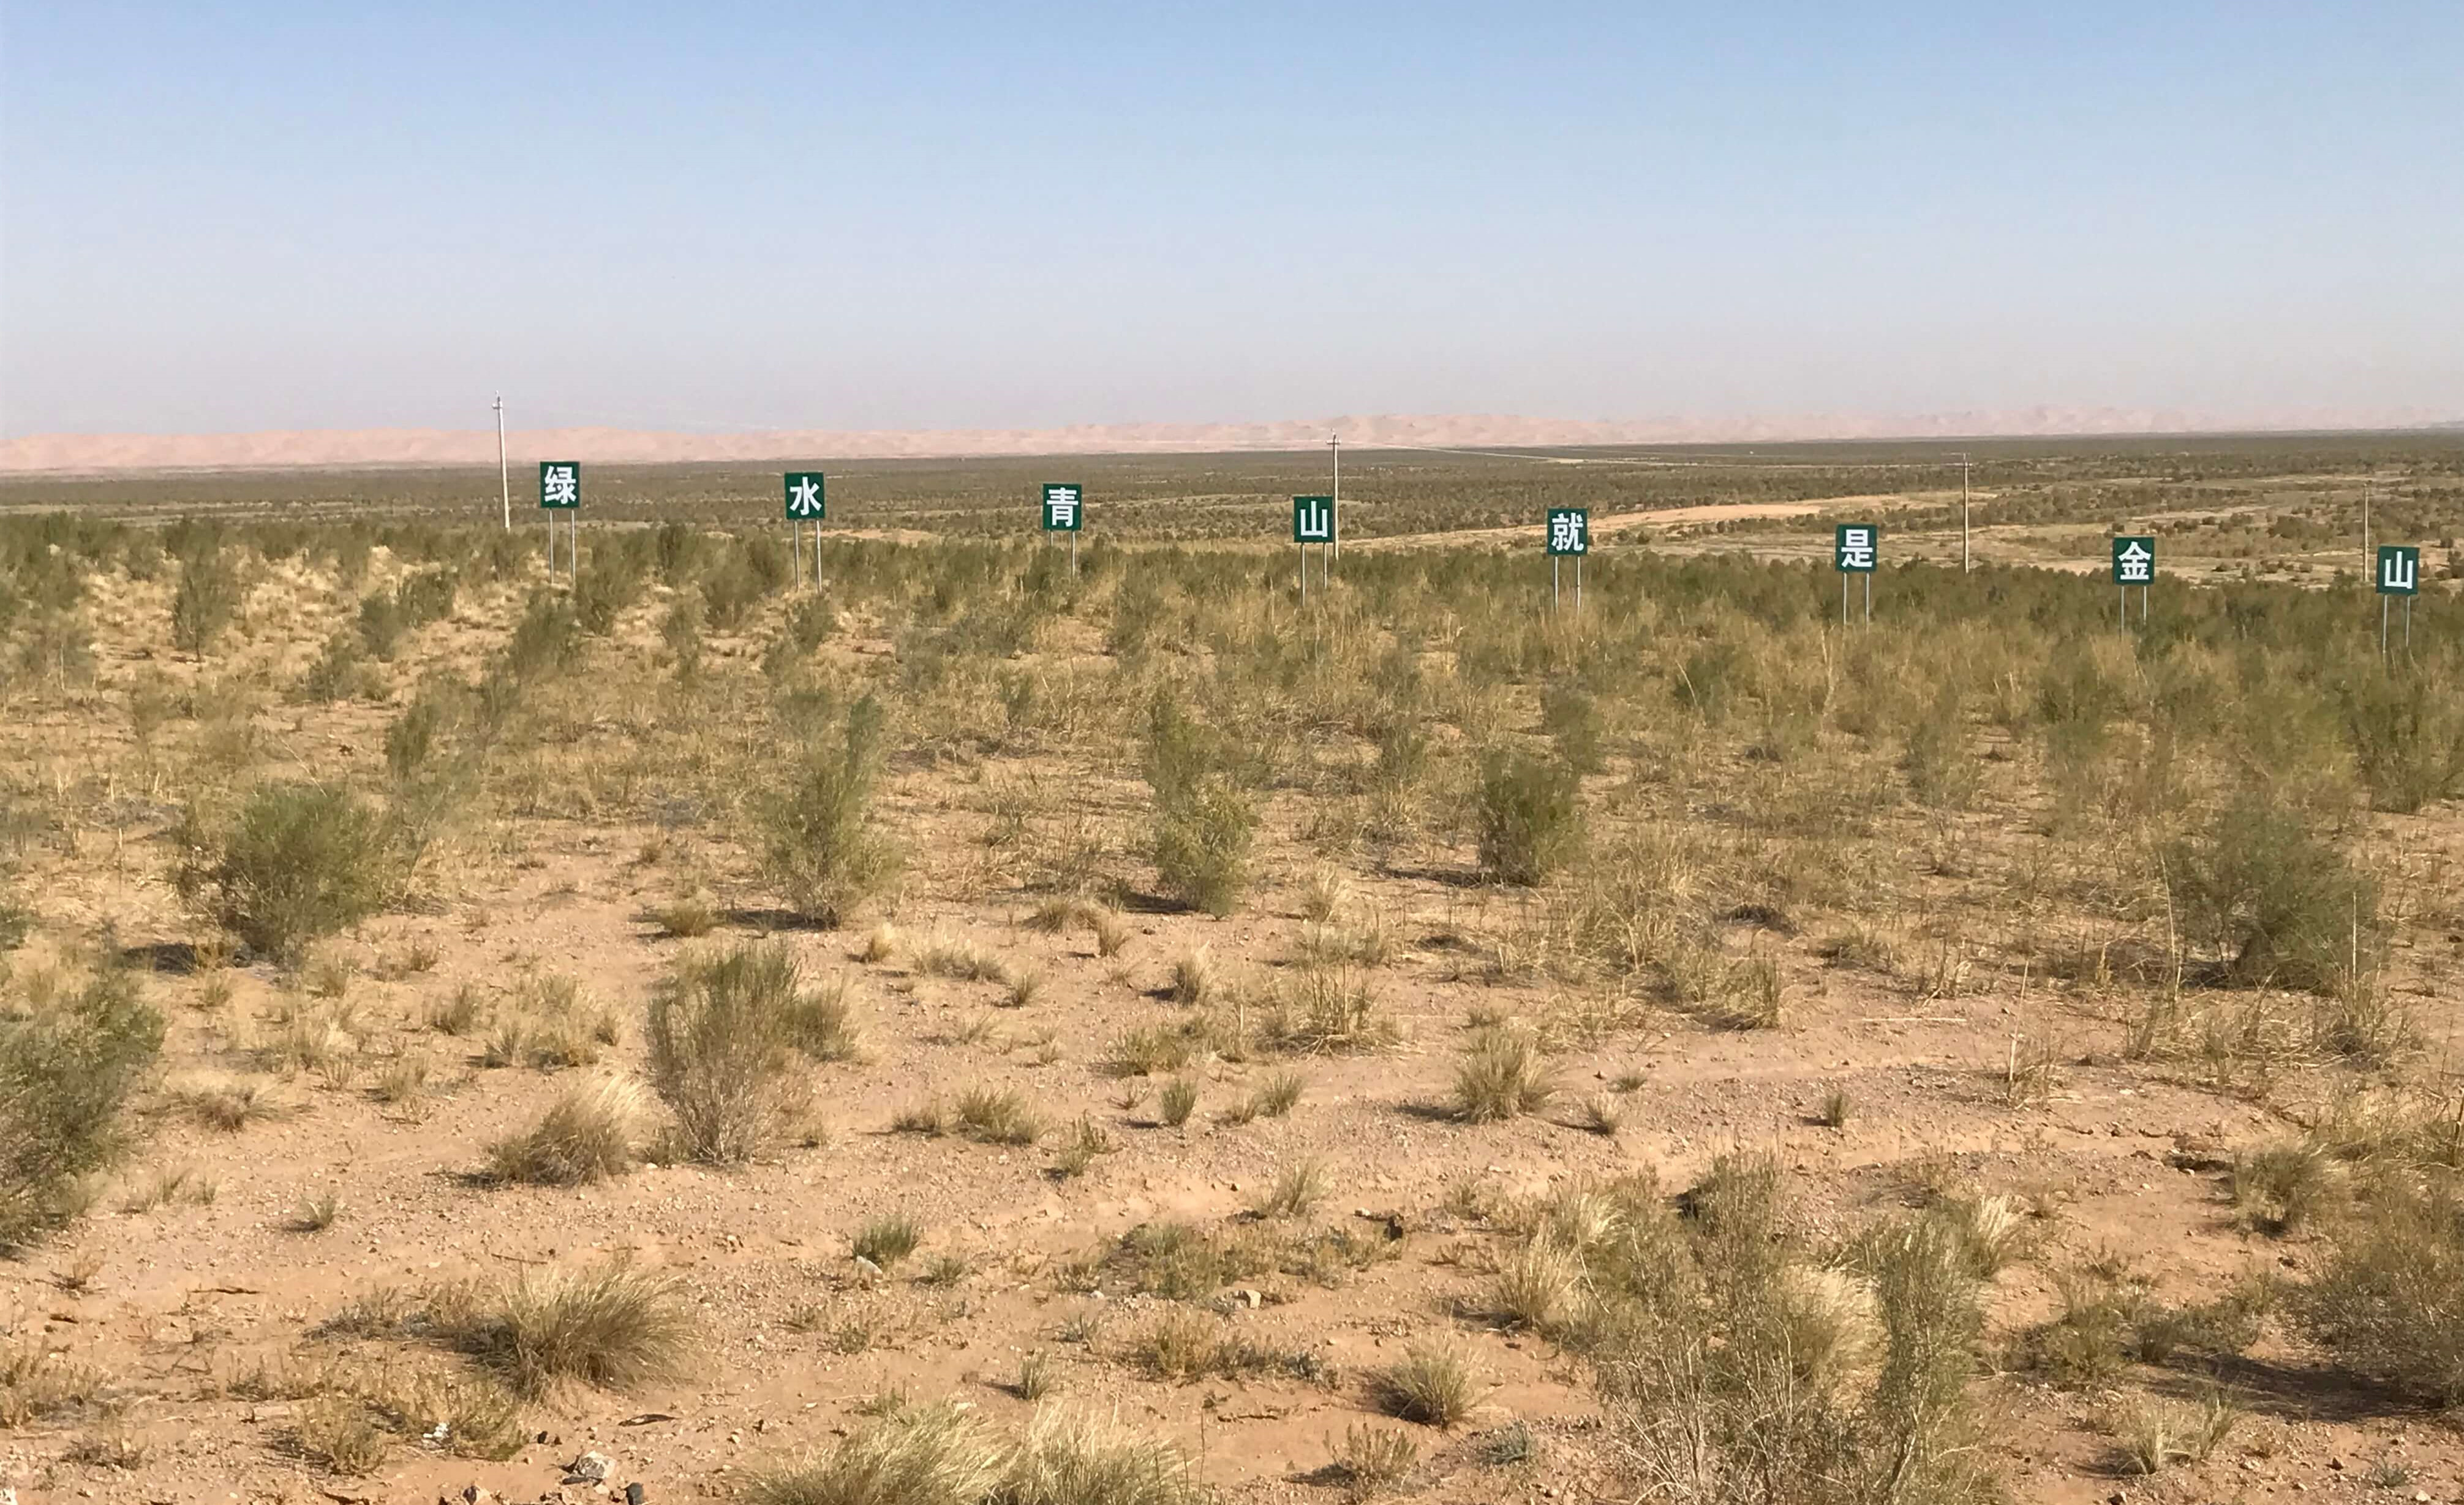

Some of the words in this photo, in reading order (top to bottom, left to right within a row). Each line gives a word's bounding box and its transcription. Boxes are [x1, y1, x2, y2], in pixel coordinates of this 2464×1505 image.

[544, 466, 576, 505] 绿
[789, 477, 821, 516] 水
[1046, 488, 1079, 527] 青
[1301, 501, 1328, 537] 山
[1552, 512, 1584, 551] 就
[1841, 529, 1872, 567] 是
[2119, 541, 2151, 579] 金
[2385, 551, 2413, 589] 山
